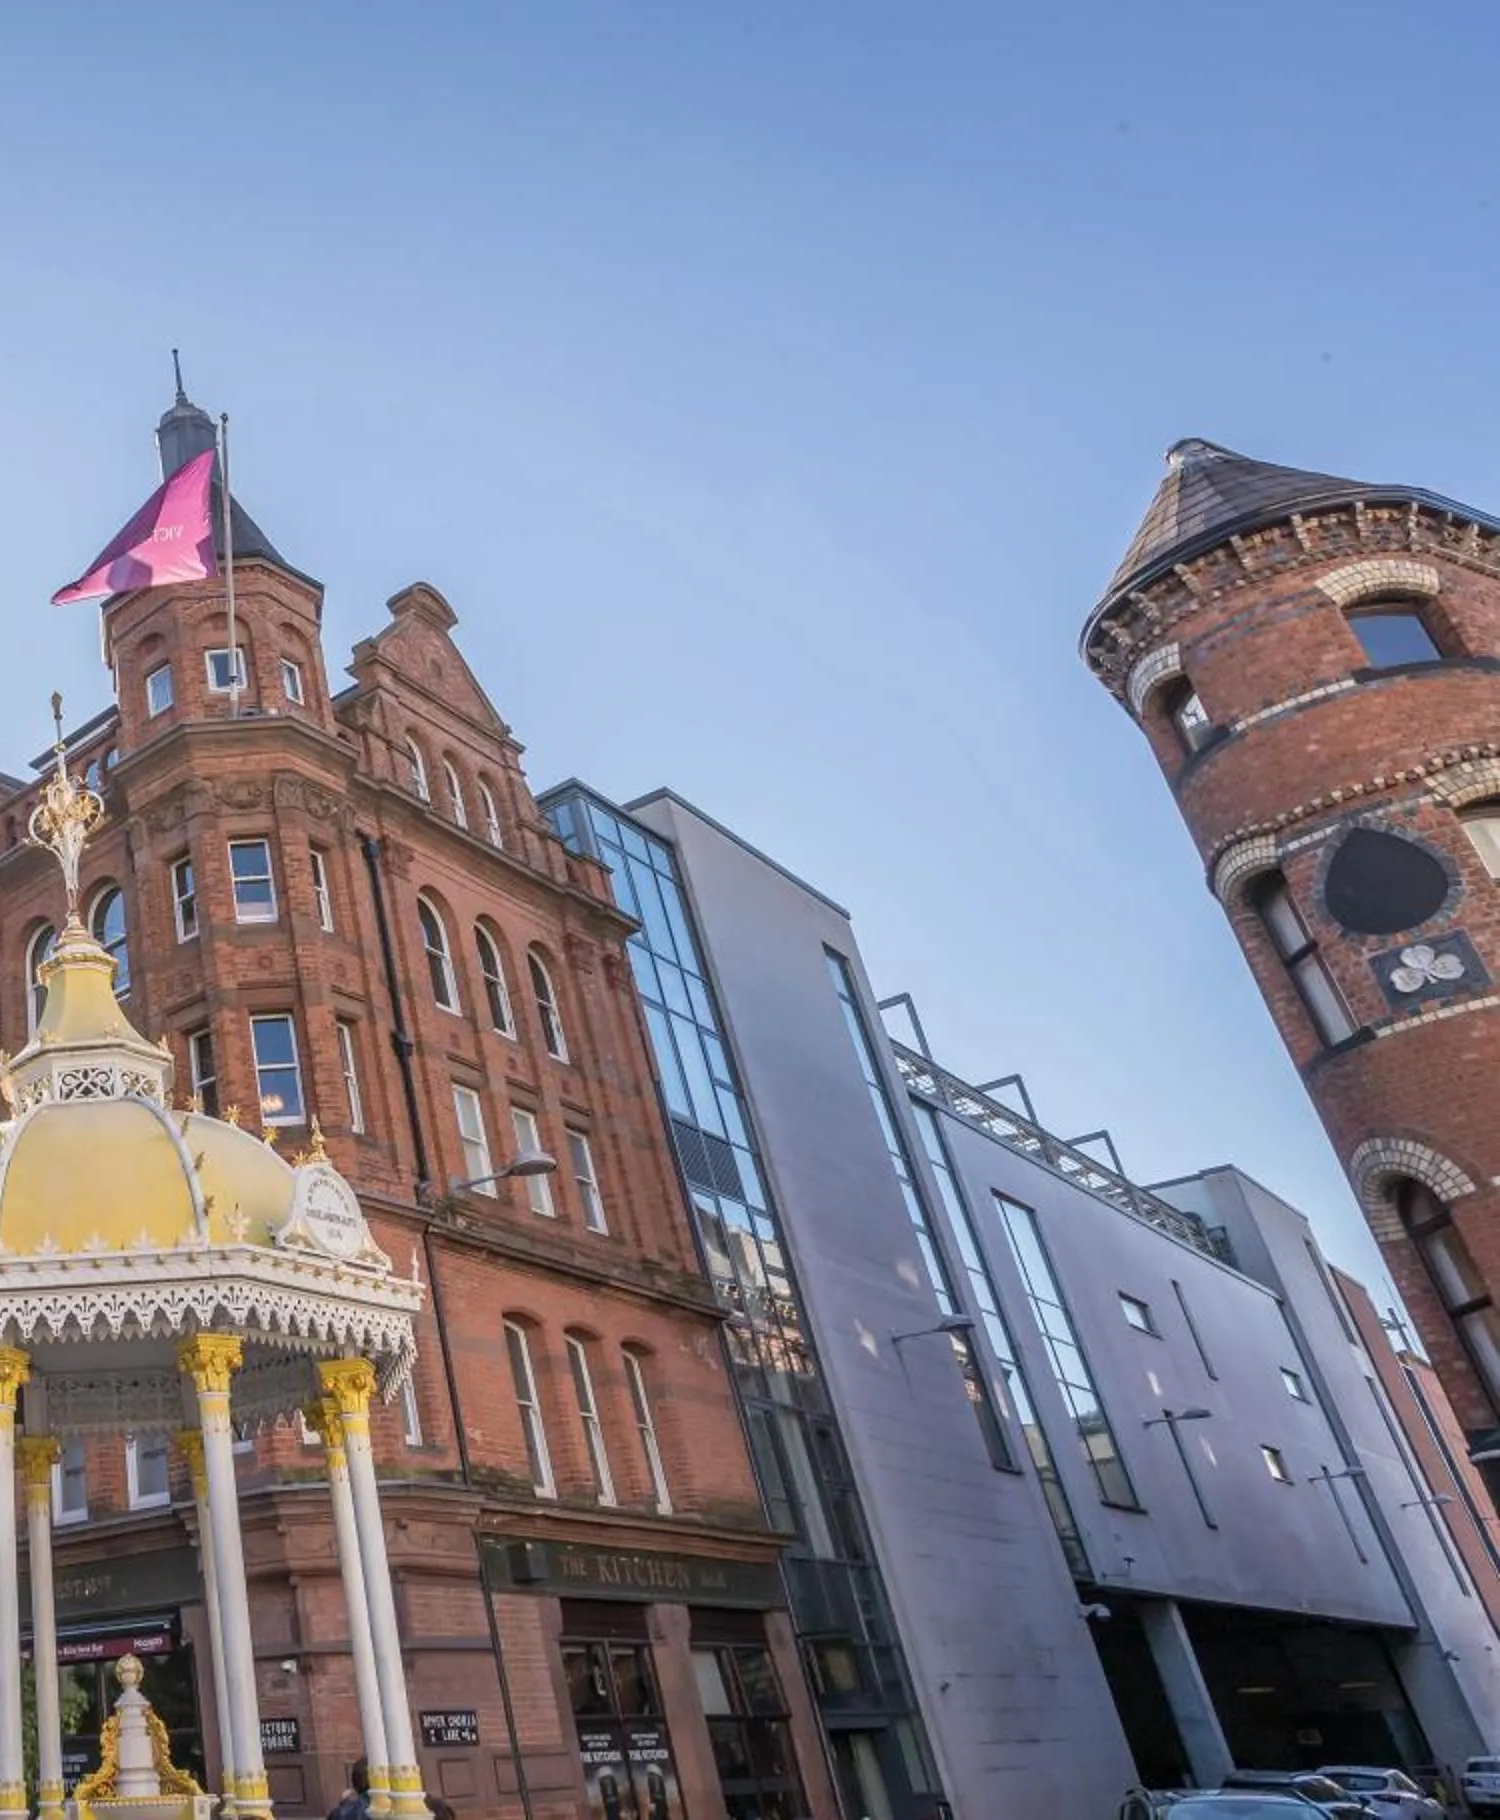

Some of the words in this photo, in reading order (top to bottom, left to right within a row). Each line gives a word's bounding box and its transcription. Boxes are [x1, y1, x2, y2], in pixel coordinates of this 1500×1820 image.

[559, 1555, 587, 1576] THE
[596, 1554, 691, 1589] KITCHEN
[260, 1720, 297, 1735] ICTORIA
